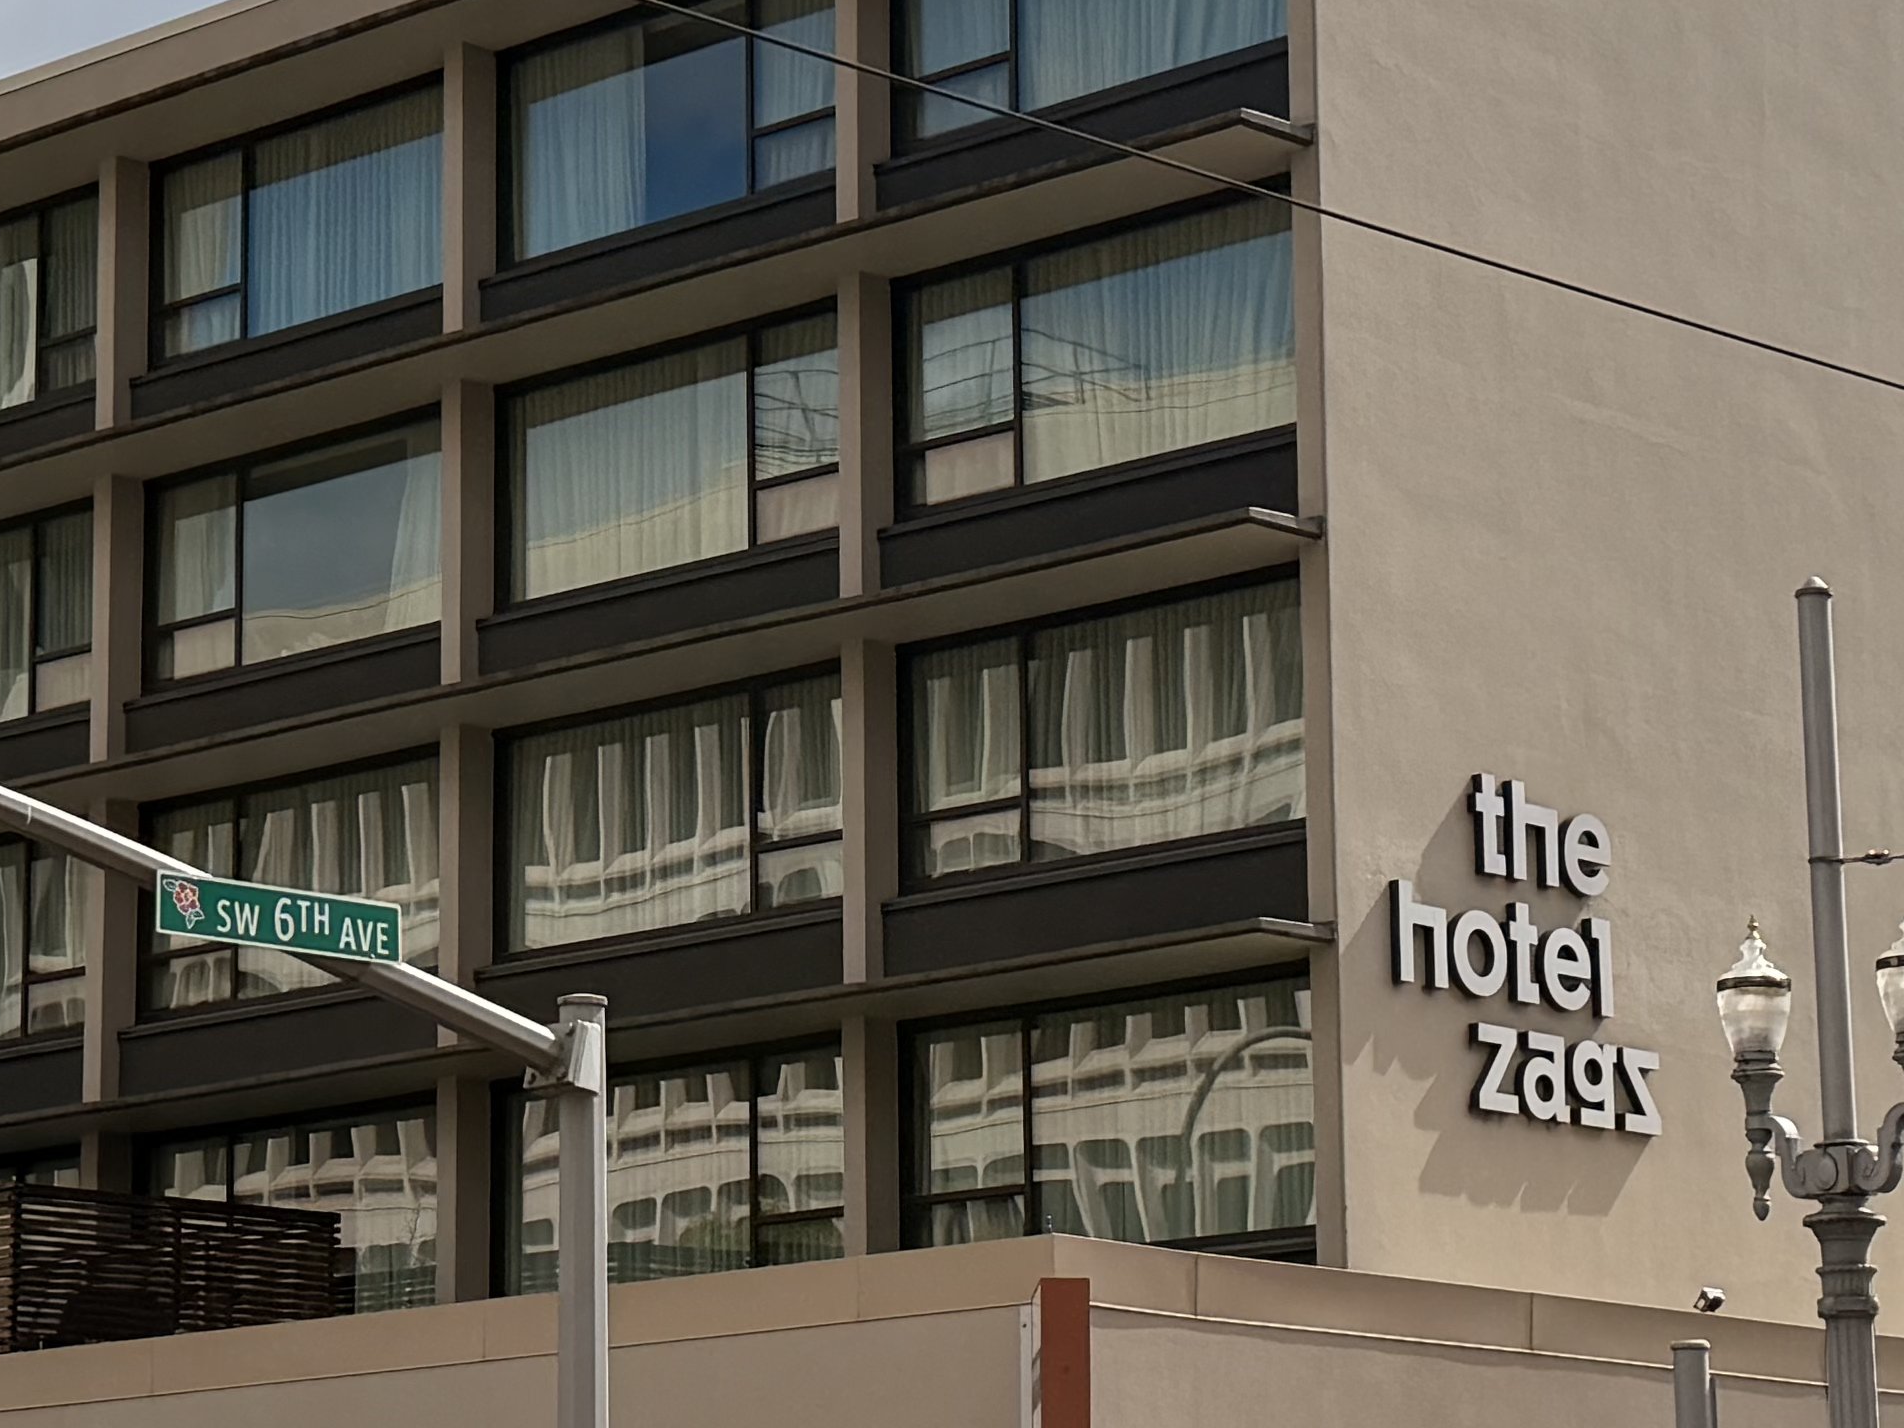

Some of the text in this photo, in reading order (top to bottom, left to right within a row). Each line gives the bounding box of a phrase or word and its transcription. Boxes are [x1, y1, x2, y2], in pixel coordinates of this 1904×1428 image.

[1468, 773, 1612, 897] the
[216, 897, 389, 955] SW 6TH AVE
[1389, 878, 1615, 1018] hotel
